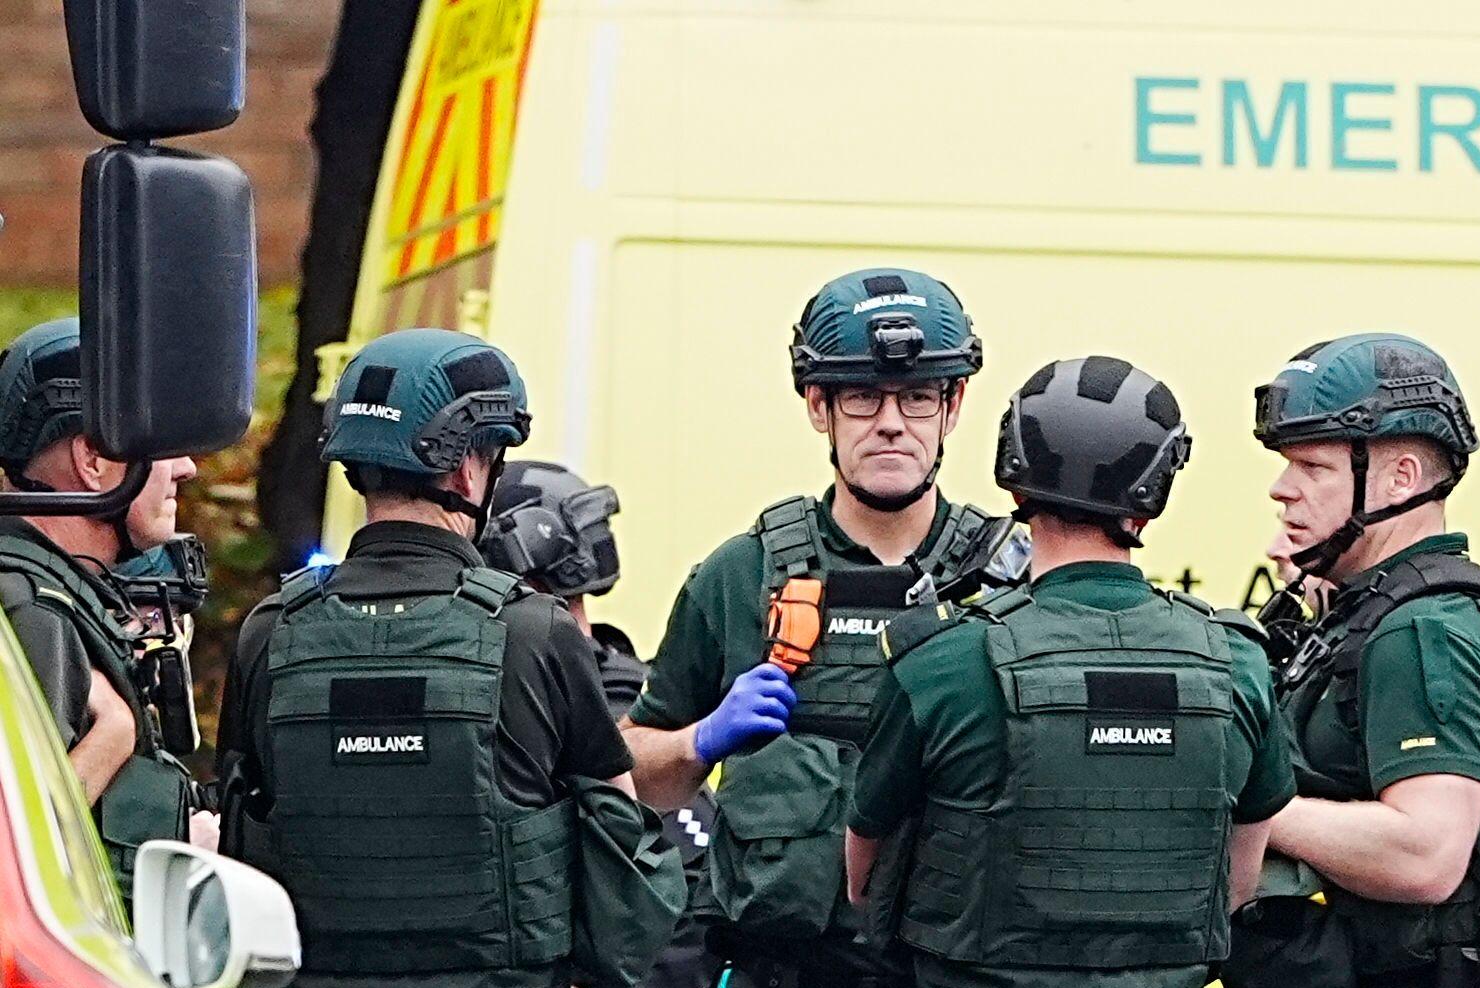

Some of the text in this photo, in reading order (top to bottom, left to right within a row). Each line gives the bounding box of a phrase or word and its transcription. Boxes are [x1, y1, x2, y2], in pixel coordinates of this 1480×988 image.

[340, 403, 401, 421] AMBULANCE
[828, 618, 891, 634] AMBULA
[337, 735, 424, 753] AMBULANCE
[1090, 727, 1172, 744] AMBULANCE
